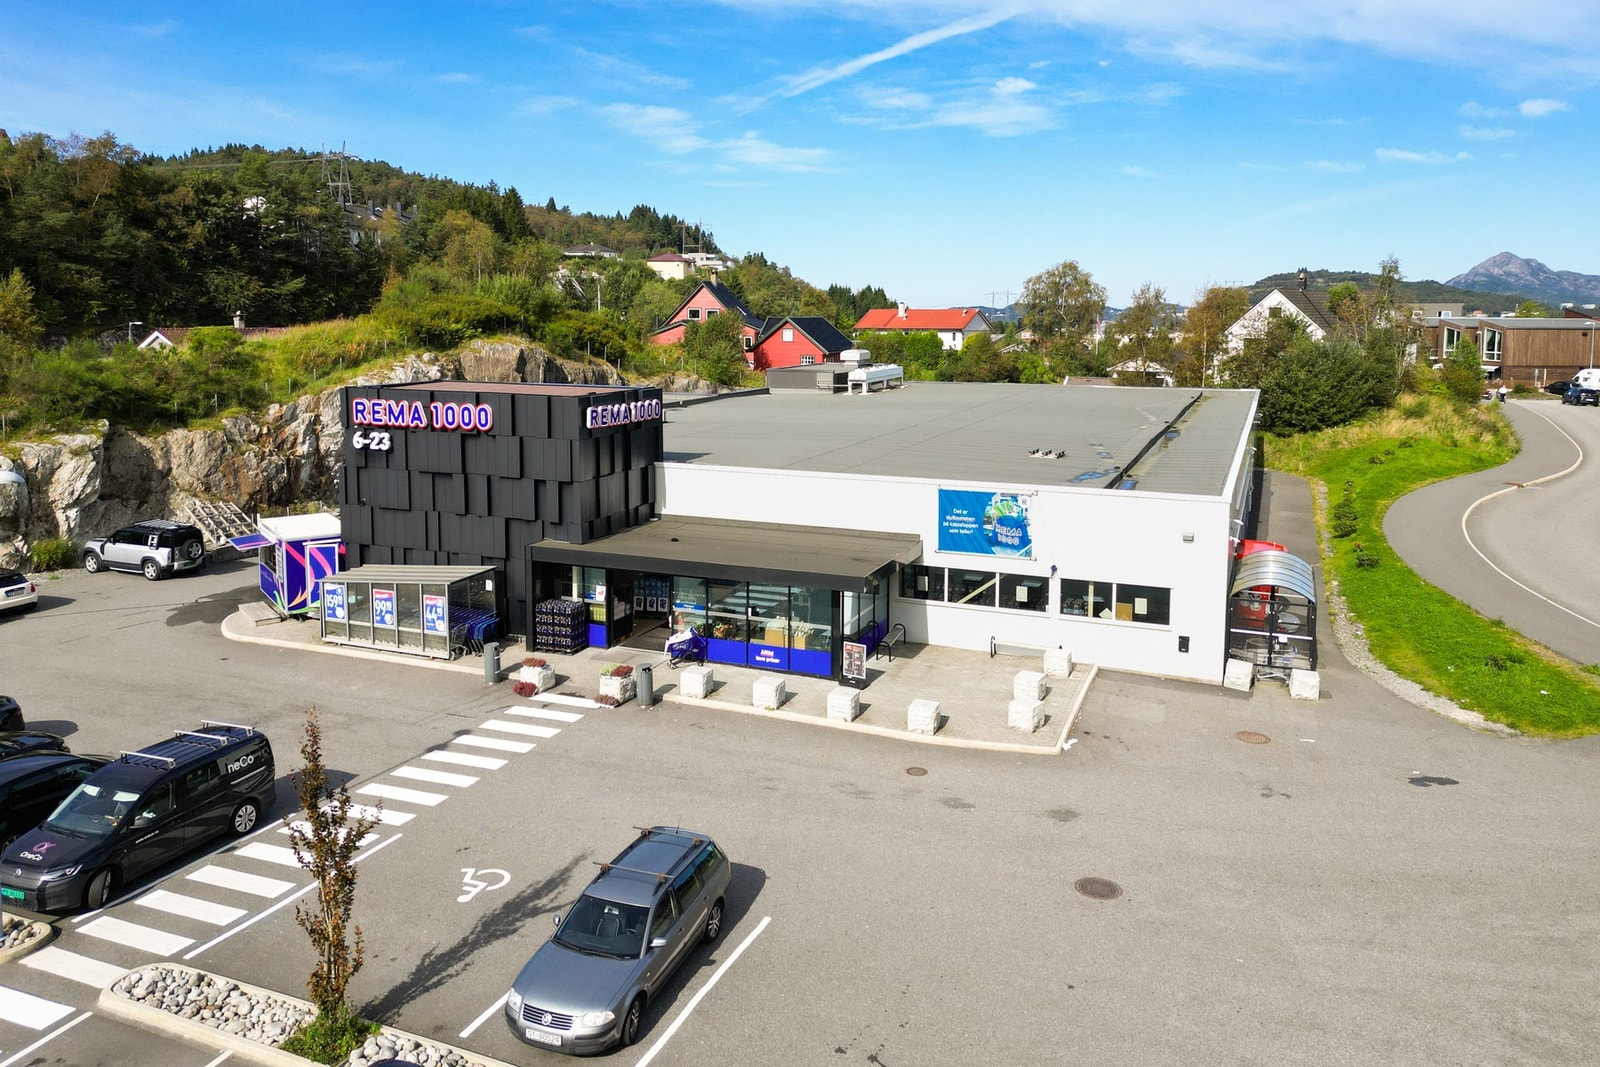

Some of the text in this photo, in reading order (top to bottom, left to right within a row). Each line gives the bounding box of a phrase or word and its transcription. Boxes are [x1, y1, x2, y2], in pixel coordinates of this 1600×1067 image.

[352, 399, 494, 431] REMA 1000
[586, 398, 661, 429] REMA 1000
[352, 431, 391, 451] 6-23
[996, 524, 1022, 537] REMA
[997, 533, 1020, 546] 1000
